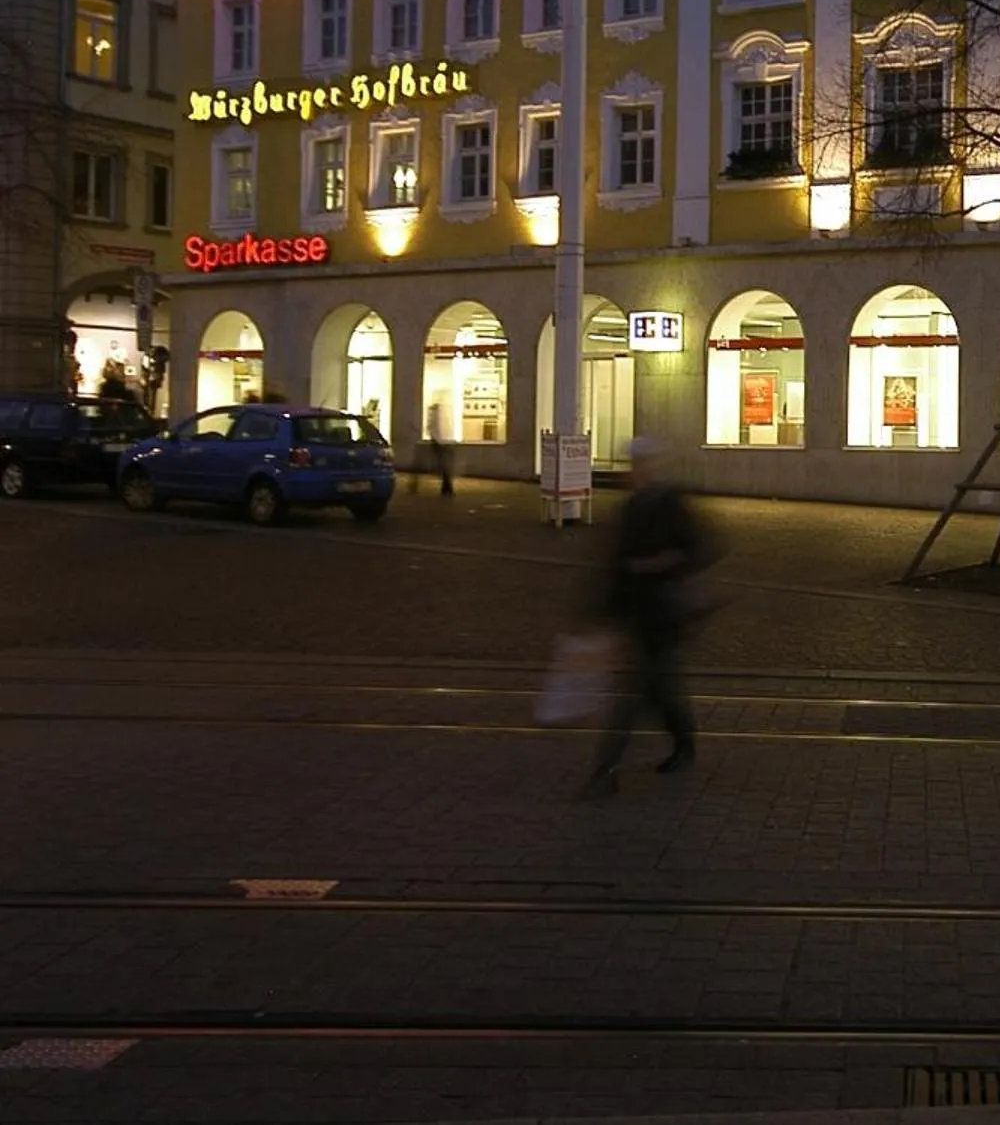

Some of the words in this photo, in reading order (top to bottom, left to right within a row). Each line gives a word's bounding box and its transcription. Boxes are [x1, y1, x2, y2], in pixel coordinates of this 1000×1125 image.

[188, 80, 343, 126] Würzburger
[350, 62, 469, 107] Hofbräu
[184, 232, 328, 272] Sparkasse
